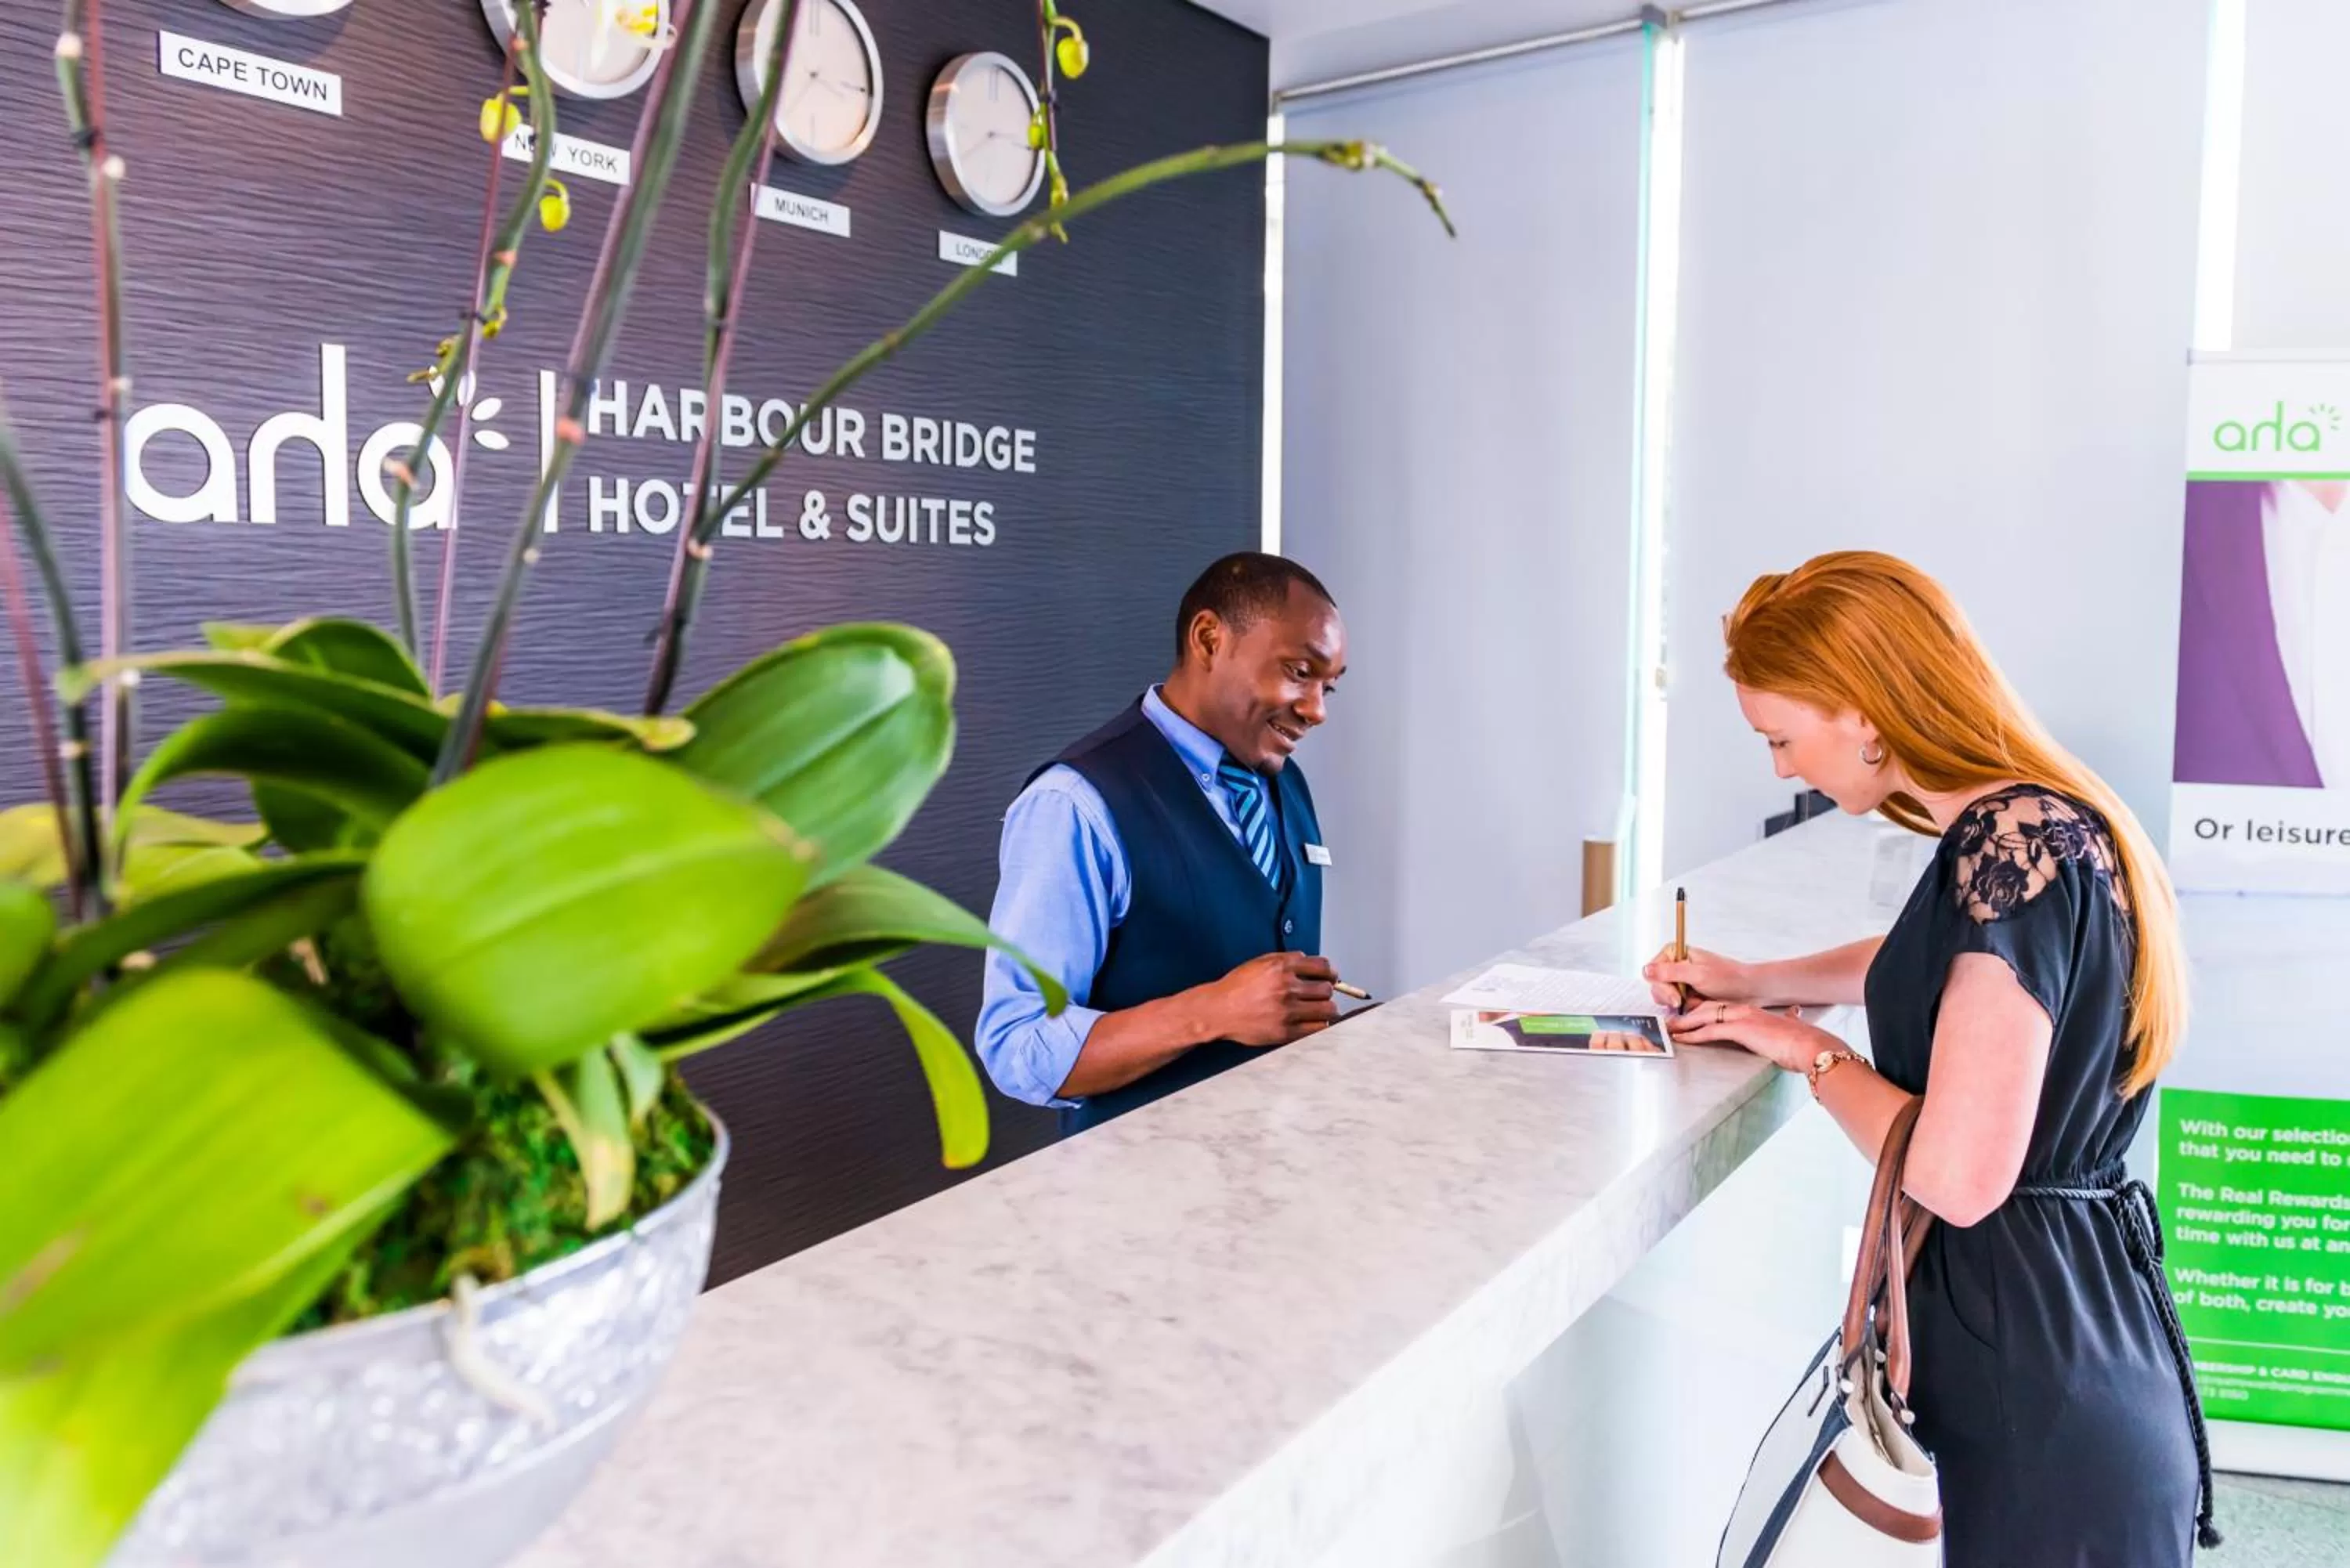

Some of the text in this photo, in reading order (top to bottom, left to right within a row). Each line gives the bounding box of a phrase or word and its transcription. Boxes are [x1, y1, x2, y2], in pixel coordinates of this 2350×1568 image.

[177, 47, 327, 101] CAPE TOWN
[514, 132, 618, 174] NW YORK
[775, 196, 829, 223] MUNICH
[955, 242, 1005, 266] LOND
[588, 378, 1036, 473] HARBOUR BRIDGE
[799, 490, 832, 540] &
[846, 493, 996, 546] SUITES
[2194, 818, 2350, 847] Or leisure
[2180, 1118, 2350, 1145] With our selectio
[2179, 1140, 2219, 1158] that
[2225, 1146, 2261, 1162] you
[2267, 1149, 2316, 1165] need
[2320, 1151, 2342, 1166] to
[2177, 1182, 2215, 1201] The
[2219, 1185, 2264, 1205] Real
[2176, 1207, 2350, 1231] rewarding you for
[2175, 1225, 2221, 1244] time
[2225, 1231, 2269, 1248] with
[2273, 1236, 2296, 1249] us
[2300, 1236, 2322, 1251] at
[2174, 1267, 2261, 1289] Whether
[2264, 1274, 2280, 1292] it
[2283, 1275, 2301, 1292] is
[2305, 1277, 2335, 1294] for
[2172, 1288, 2350, 1320] of both, create yo
